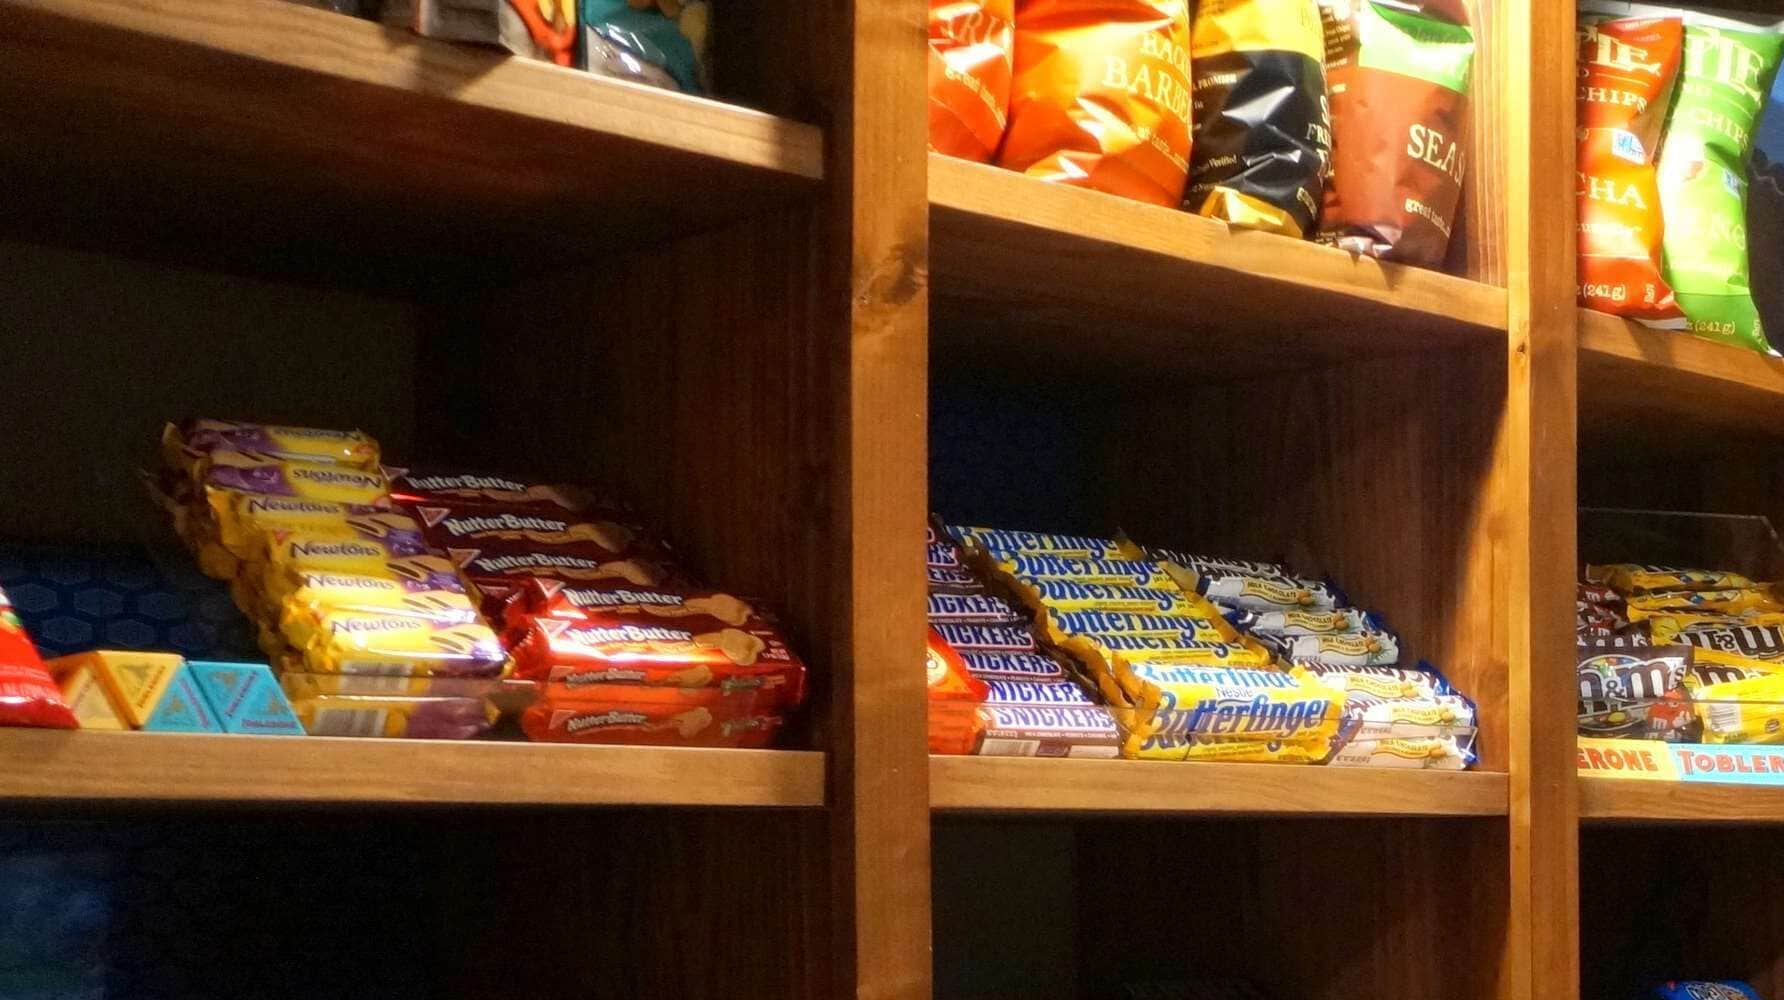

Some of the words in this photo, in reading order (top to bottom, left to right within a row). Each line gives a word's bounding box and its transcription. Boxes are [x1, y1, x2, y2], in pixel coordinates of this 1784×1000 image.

[249, 498, 340, 515] Newtons
[289, 542, 382, 559] Newtons
[303, 572, 394, 591] Newtons
[330, 617, 422, 635] Newtons
[999, 706, 1115, 729] SNICKERS
[1150, 691, 1329, 737] Butterfinger
